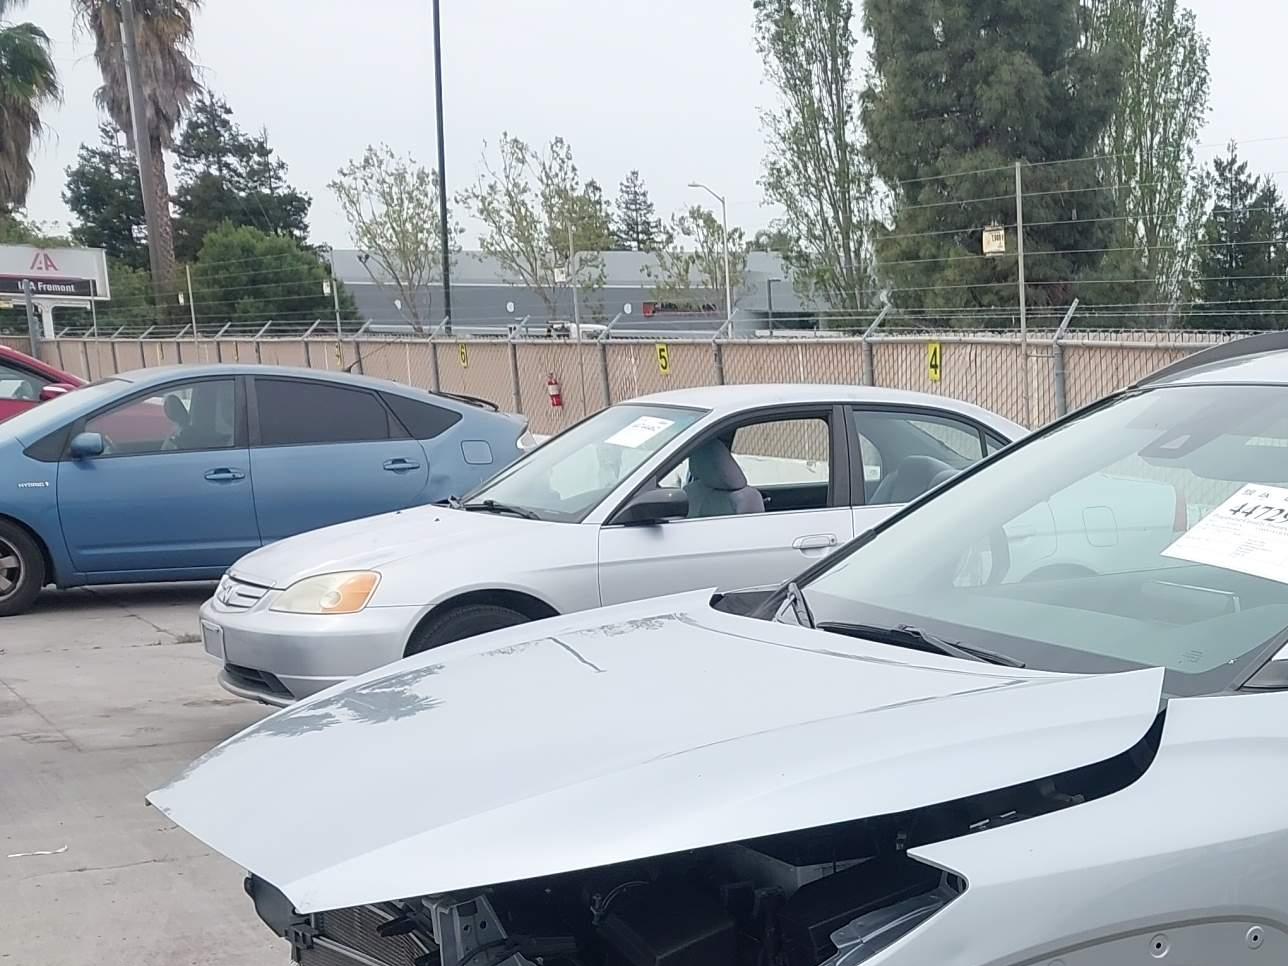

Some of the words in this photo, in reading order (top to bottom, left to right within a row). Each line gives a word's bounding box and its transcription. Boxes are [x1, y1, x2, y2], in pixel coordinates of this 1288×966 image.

[38, 282, 75, 292] Fremont
[658, 347, 668, 369] 5
[930, 346, 938, 374] 4
